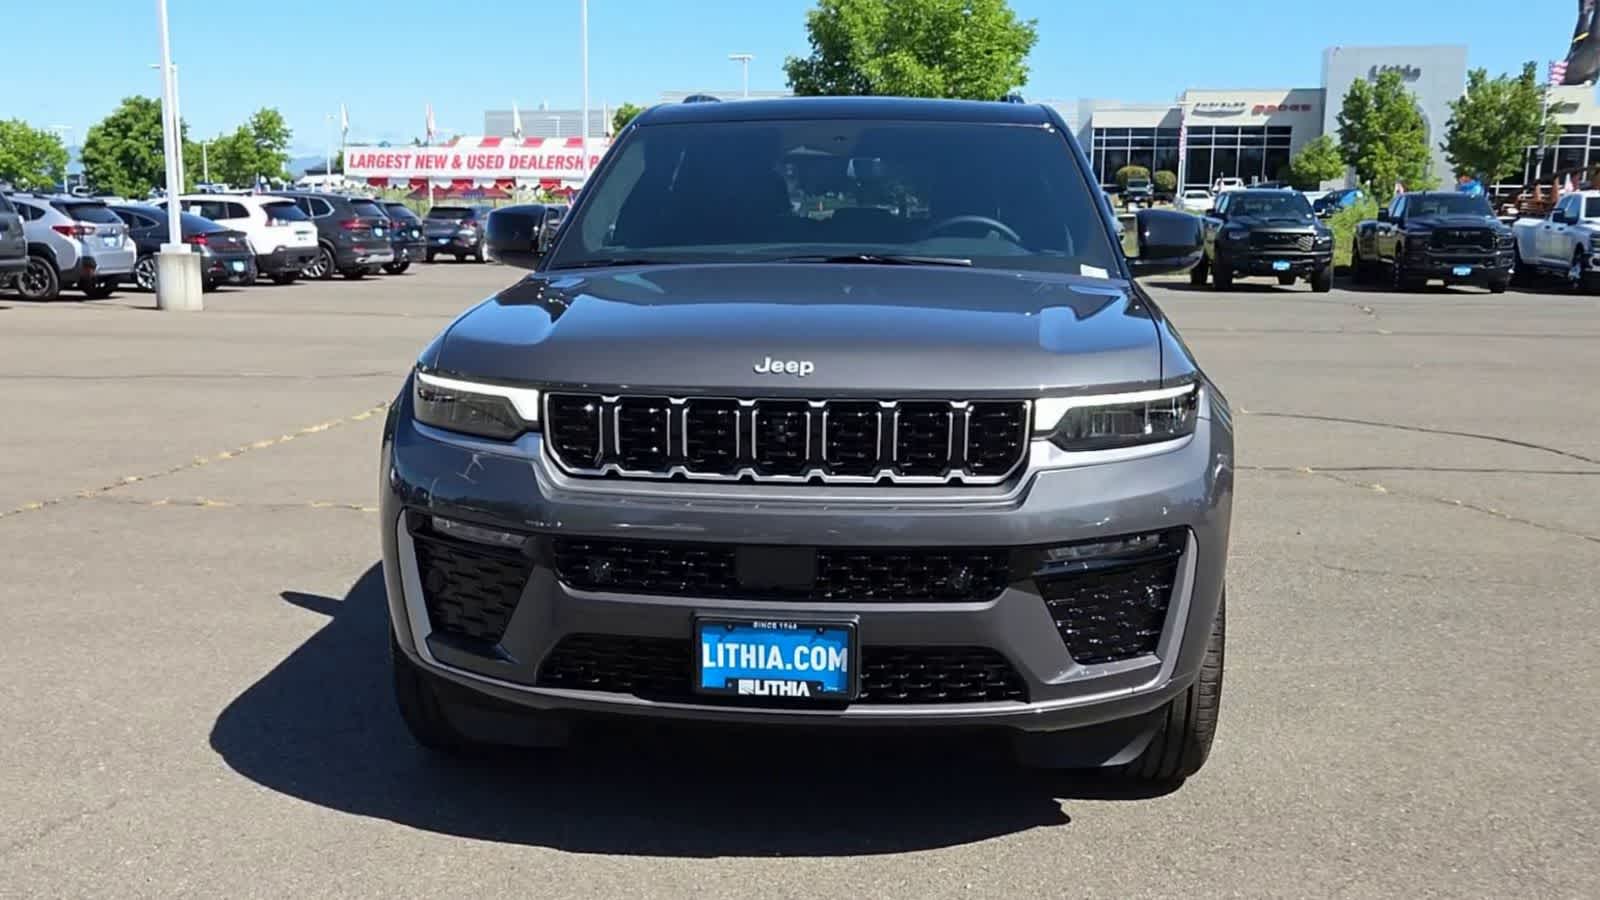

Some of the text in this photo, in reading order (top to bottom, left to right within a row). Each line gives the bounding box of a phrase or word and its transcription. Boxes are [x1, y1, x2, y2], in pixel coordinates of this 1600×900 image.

[349, 154, 600, 170] LARGEST NEW & USED DEALERSHP
[754, 357, 815, 377] Jeep
[753, 621, 777, 630] SINCE
[702, 643, 848, 672] LITHIA.COM
[755, 680, 810, 697] LITHIA
